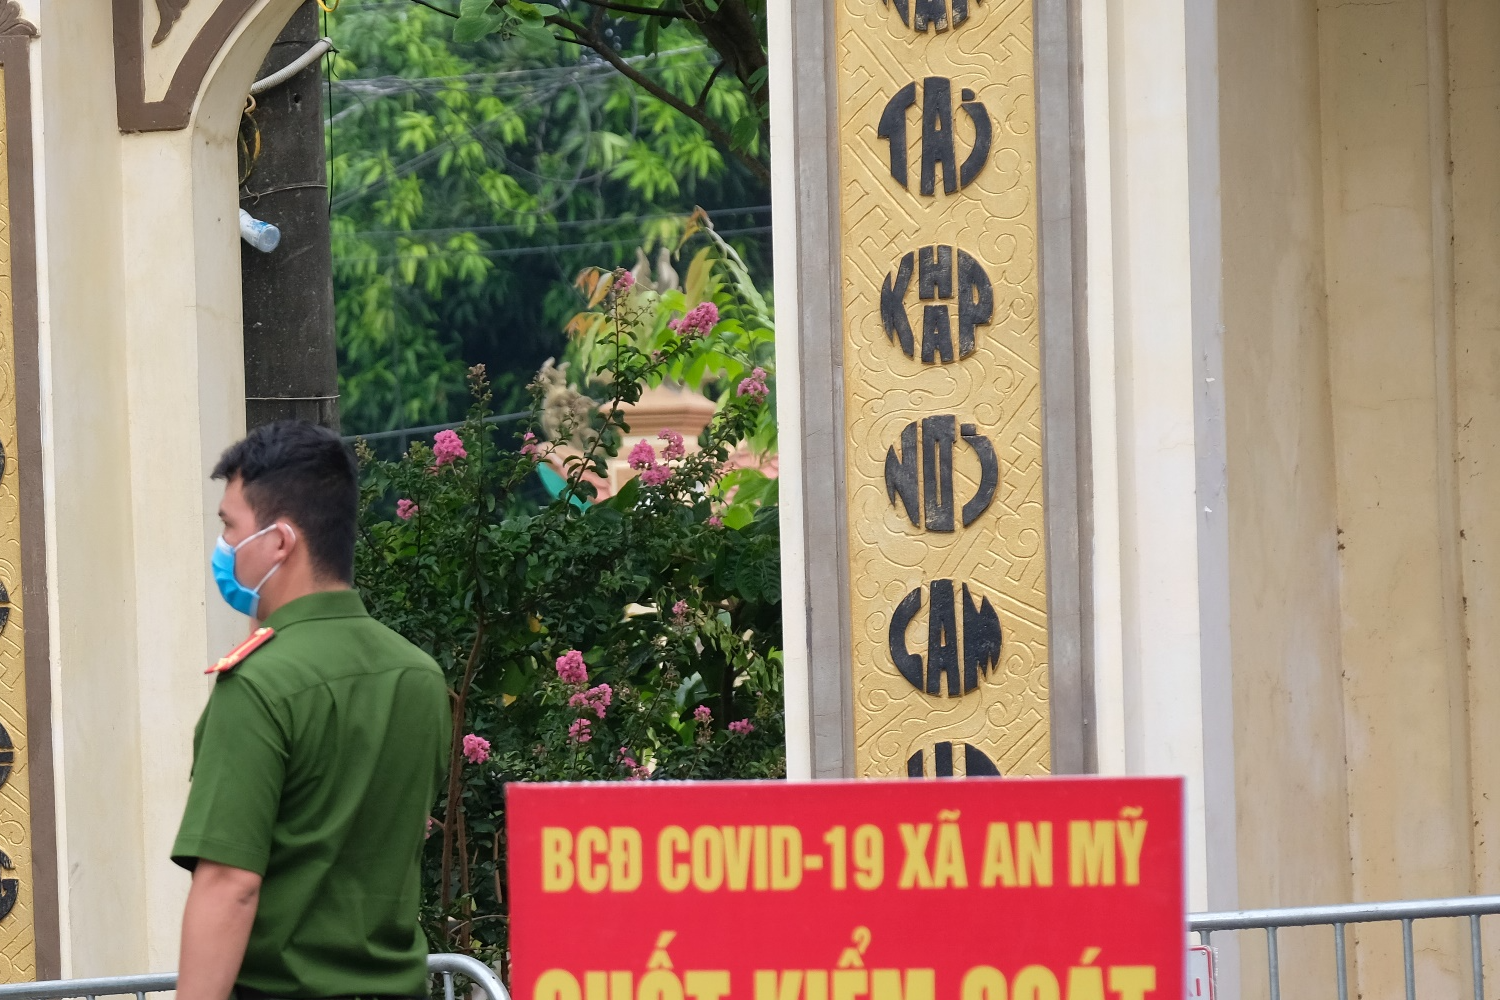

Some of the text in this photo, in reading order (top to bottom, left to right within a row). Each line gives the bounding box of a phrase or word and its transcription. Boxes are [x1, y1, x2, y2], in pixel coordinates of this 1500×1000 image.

[541, 806, 1149, 893] BCĐ COVID-19 XÃ AN MỸ
